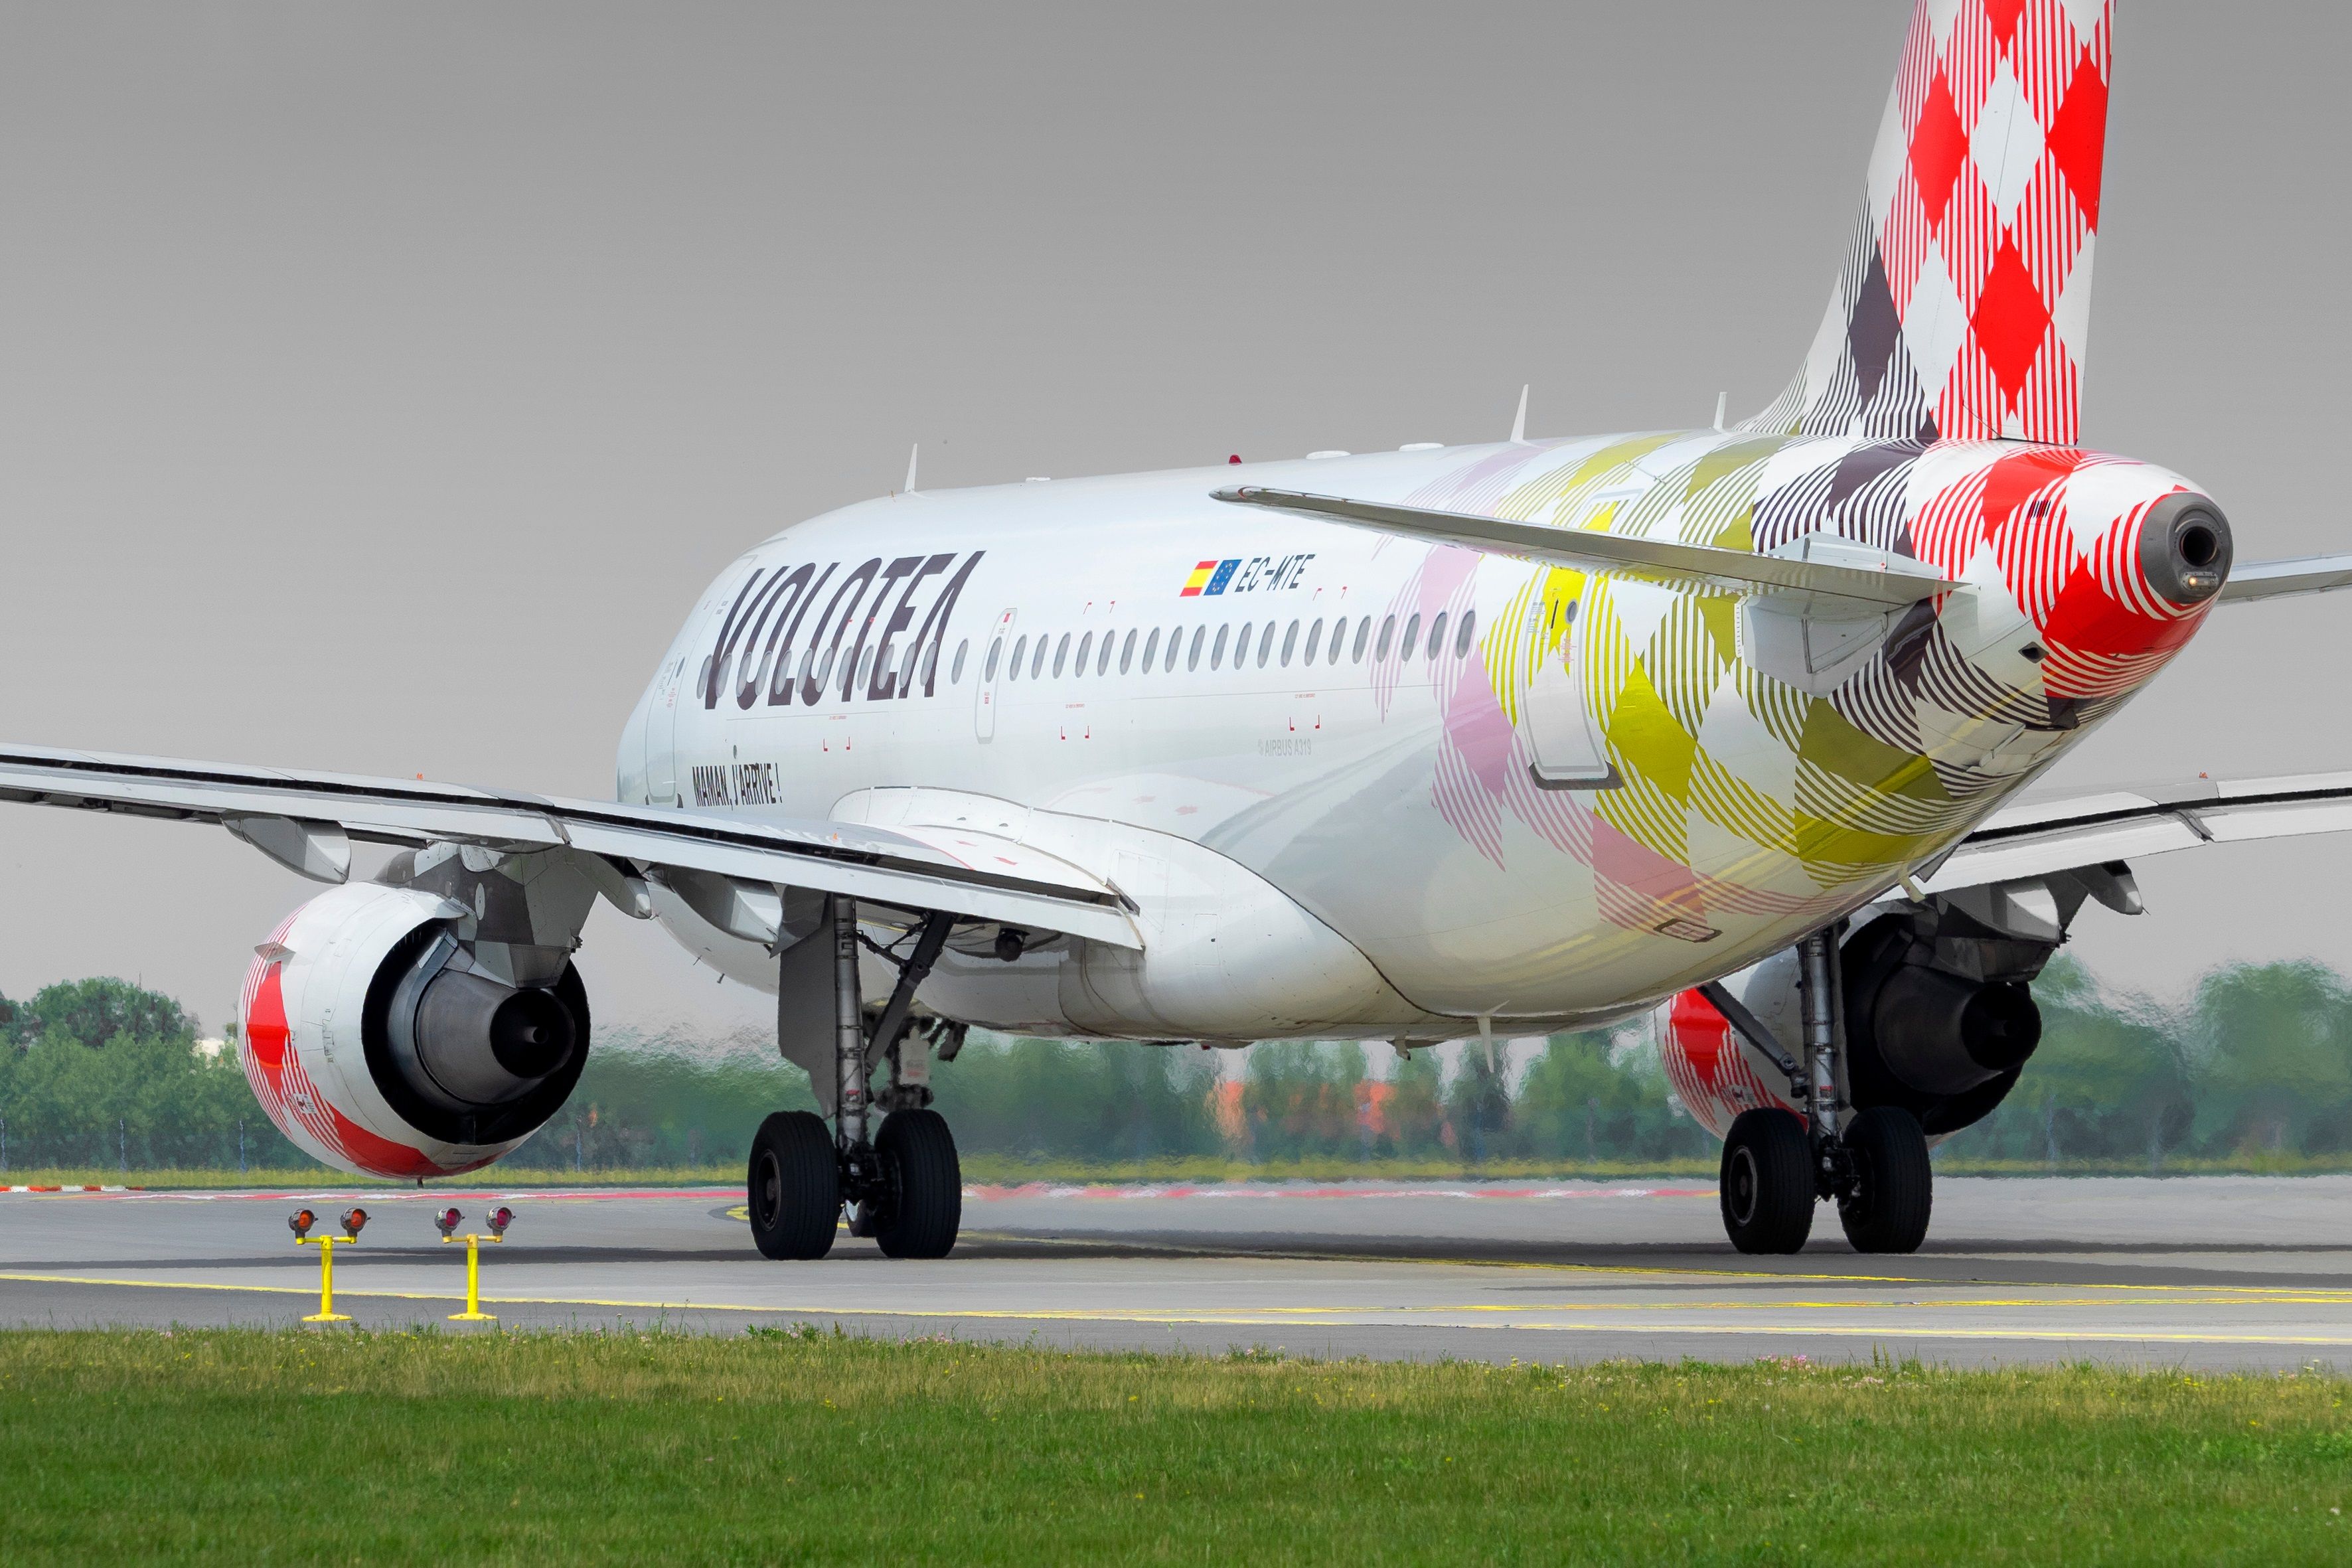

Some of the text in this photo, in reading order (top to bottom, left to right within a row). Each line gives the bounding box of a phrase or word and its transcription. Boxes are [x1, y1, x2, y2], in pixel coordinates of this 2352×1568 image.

[1234, 554, 1316, 593] EC-MTE
[705, 550, 986, 710] VOLOTEA
[1265, 738, 1312, 757] AIRBUS A319
[692, 765, 734, 811] MAMAN,
